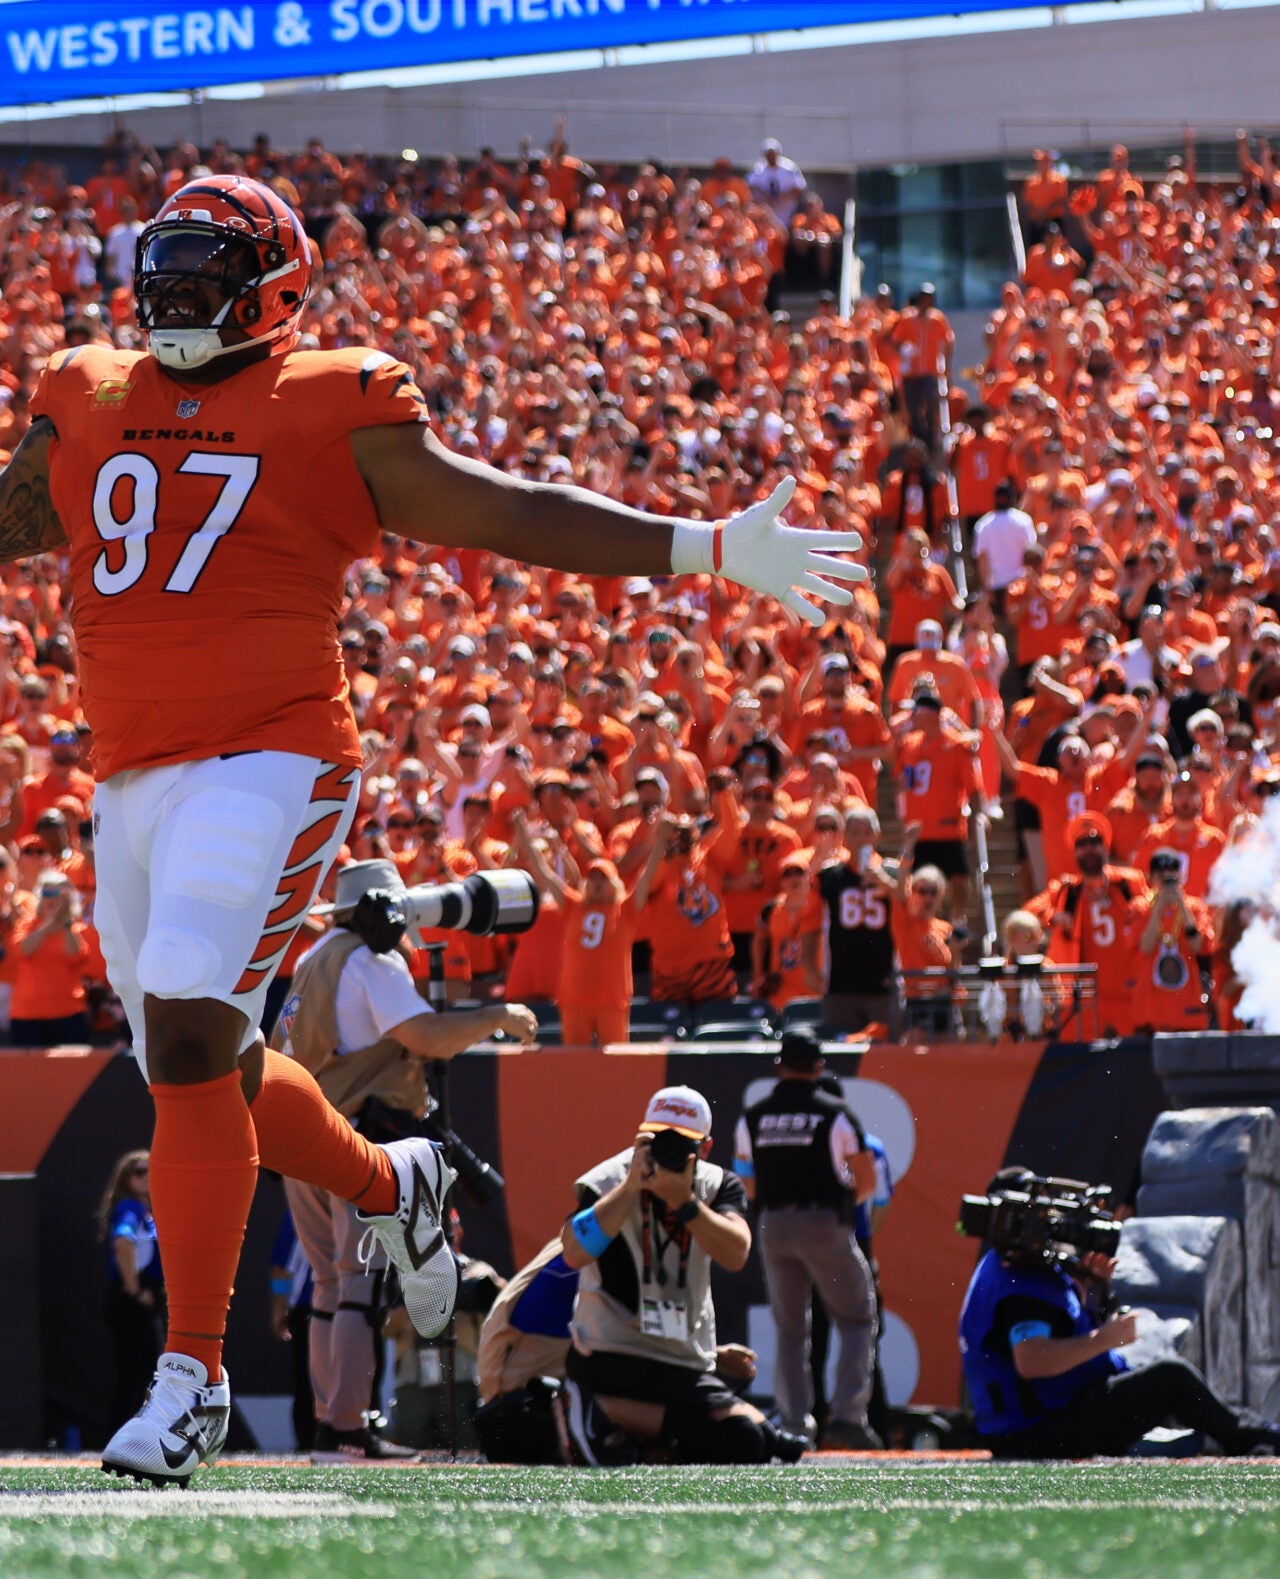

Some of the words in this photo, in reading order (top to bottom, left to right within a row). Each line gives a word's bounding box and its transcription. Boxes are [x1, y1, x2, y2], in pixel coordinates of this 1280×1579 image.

[7, 6, 254, 73] WESTERN
[274, 1, 312, 46] &
[122, 429, 236, 443] BENGALS
[93, 450, 261, 597] 97
[839, 886, 887, 930] 65
[1090, 897, 1116, 947] 5
[580, 910, 607, 950] 9
[760, 1113, 824, 1132] BEST
[163, 1361, 196, 1378] ALPHA
